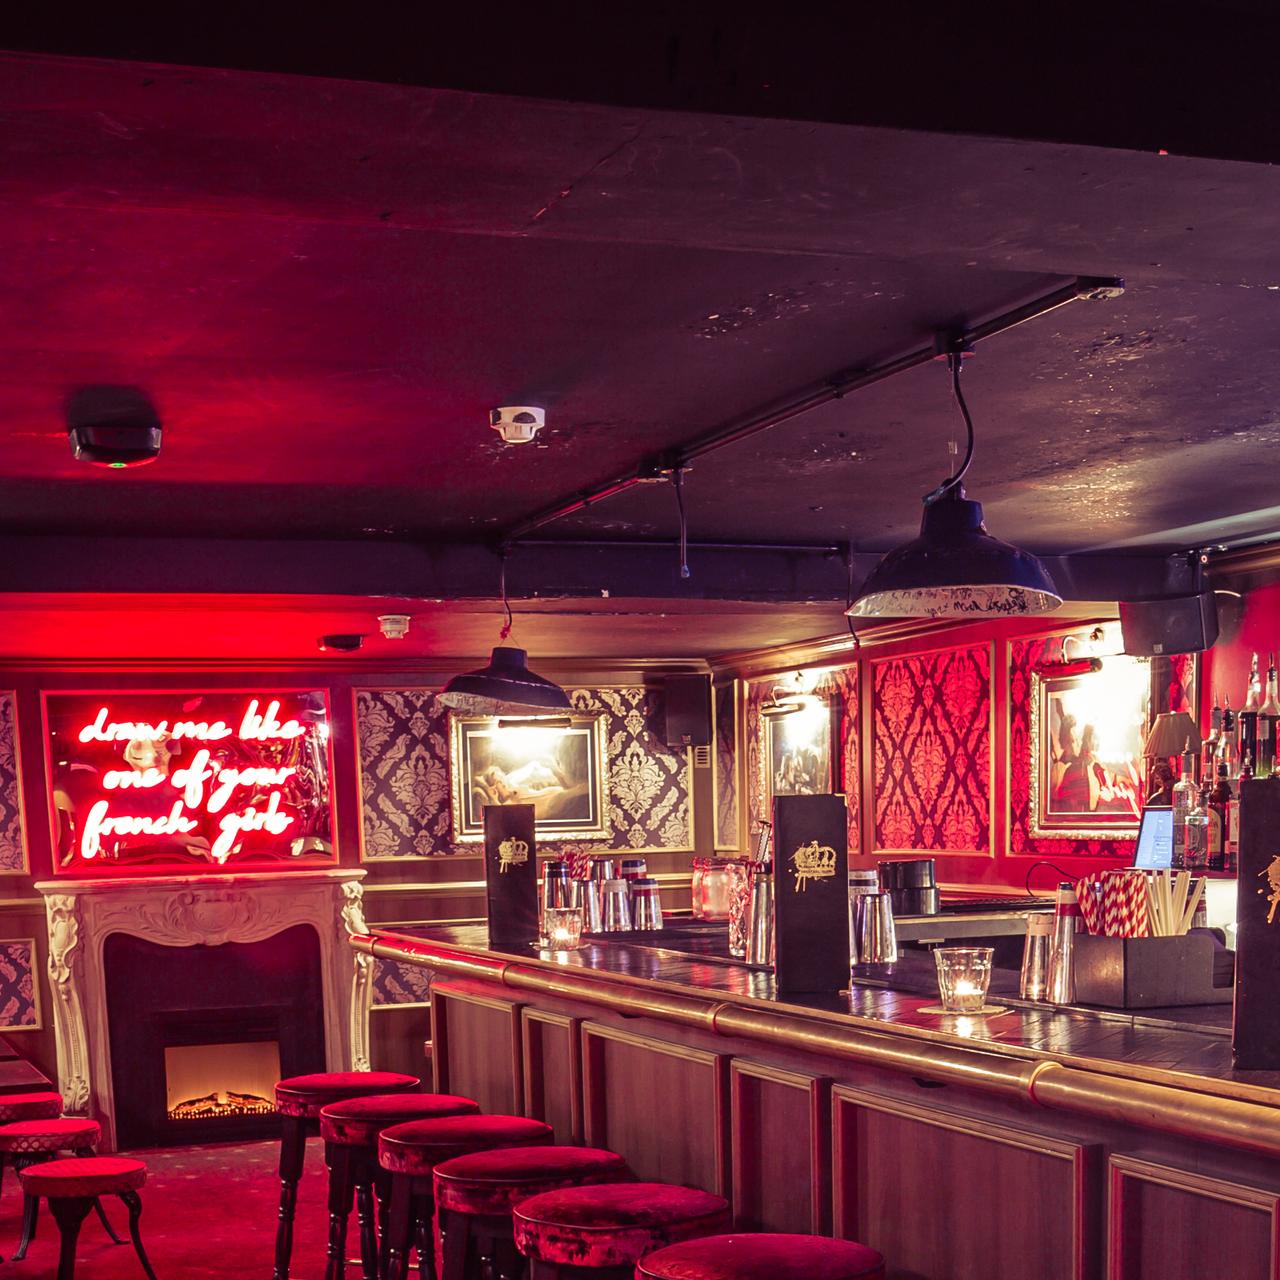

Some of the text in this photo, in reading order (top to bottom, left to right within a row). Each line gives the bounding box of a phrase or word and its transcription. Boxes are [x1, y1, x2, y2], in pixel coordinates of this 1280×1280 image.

[78, 698, 306, 744] draw me like
[102, 748, 297, 814] one of your
[80, 791, 295, 859] french girls
